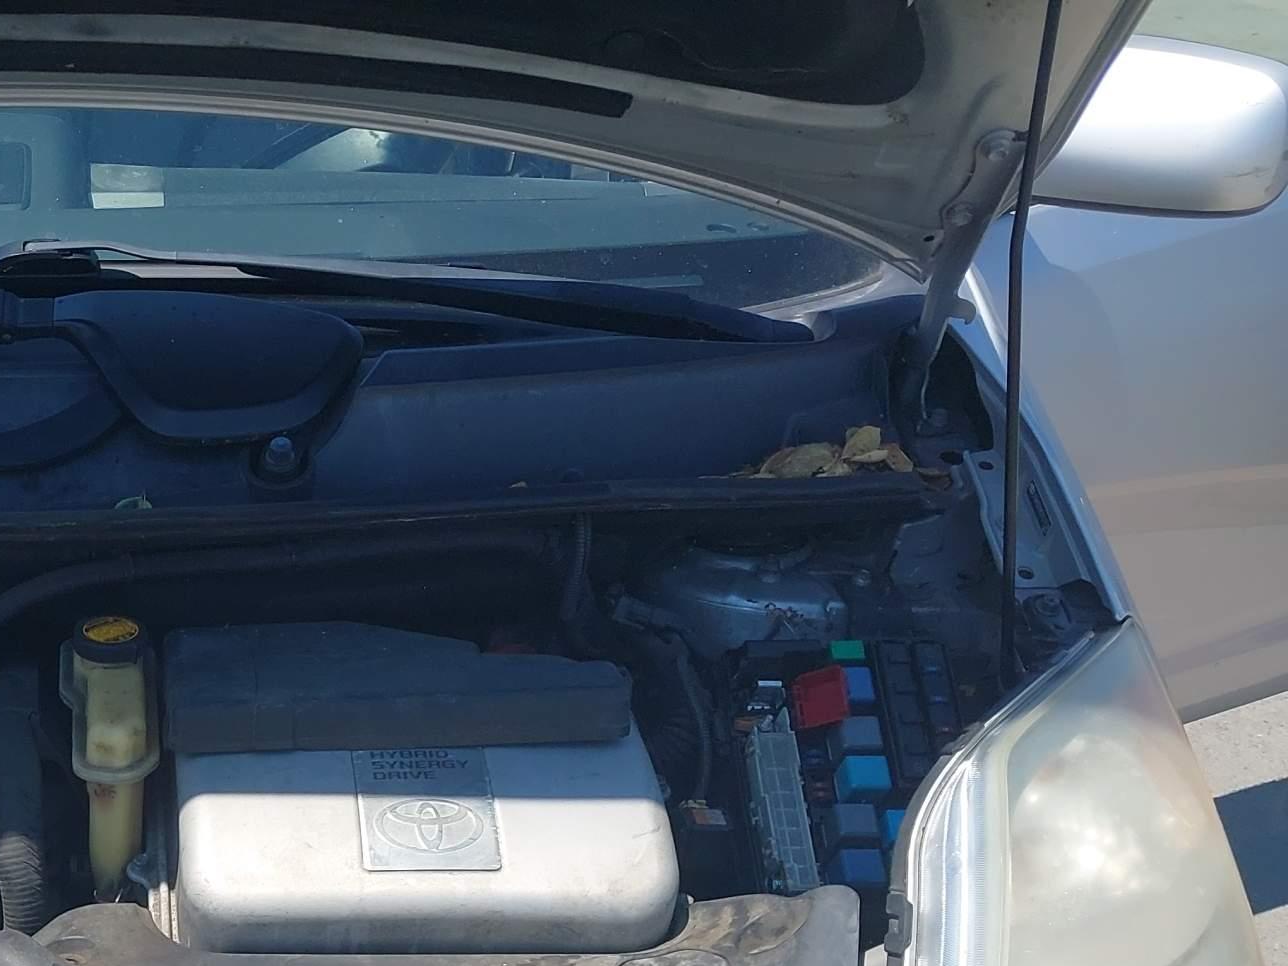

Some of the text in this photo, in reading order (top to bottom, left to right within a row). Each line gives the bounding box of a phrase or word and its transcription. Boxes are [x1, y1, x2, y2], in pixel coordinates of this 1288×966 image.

[369, 750, 449, 760] HYBRID
[371, 760, 469, 770] SYNERGY
[372, 770, 437, 780] DRIVE
